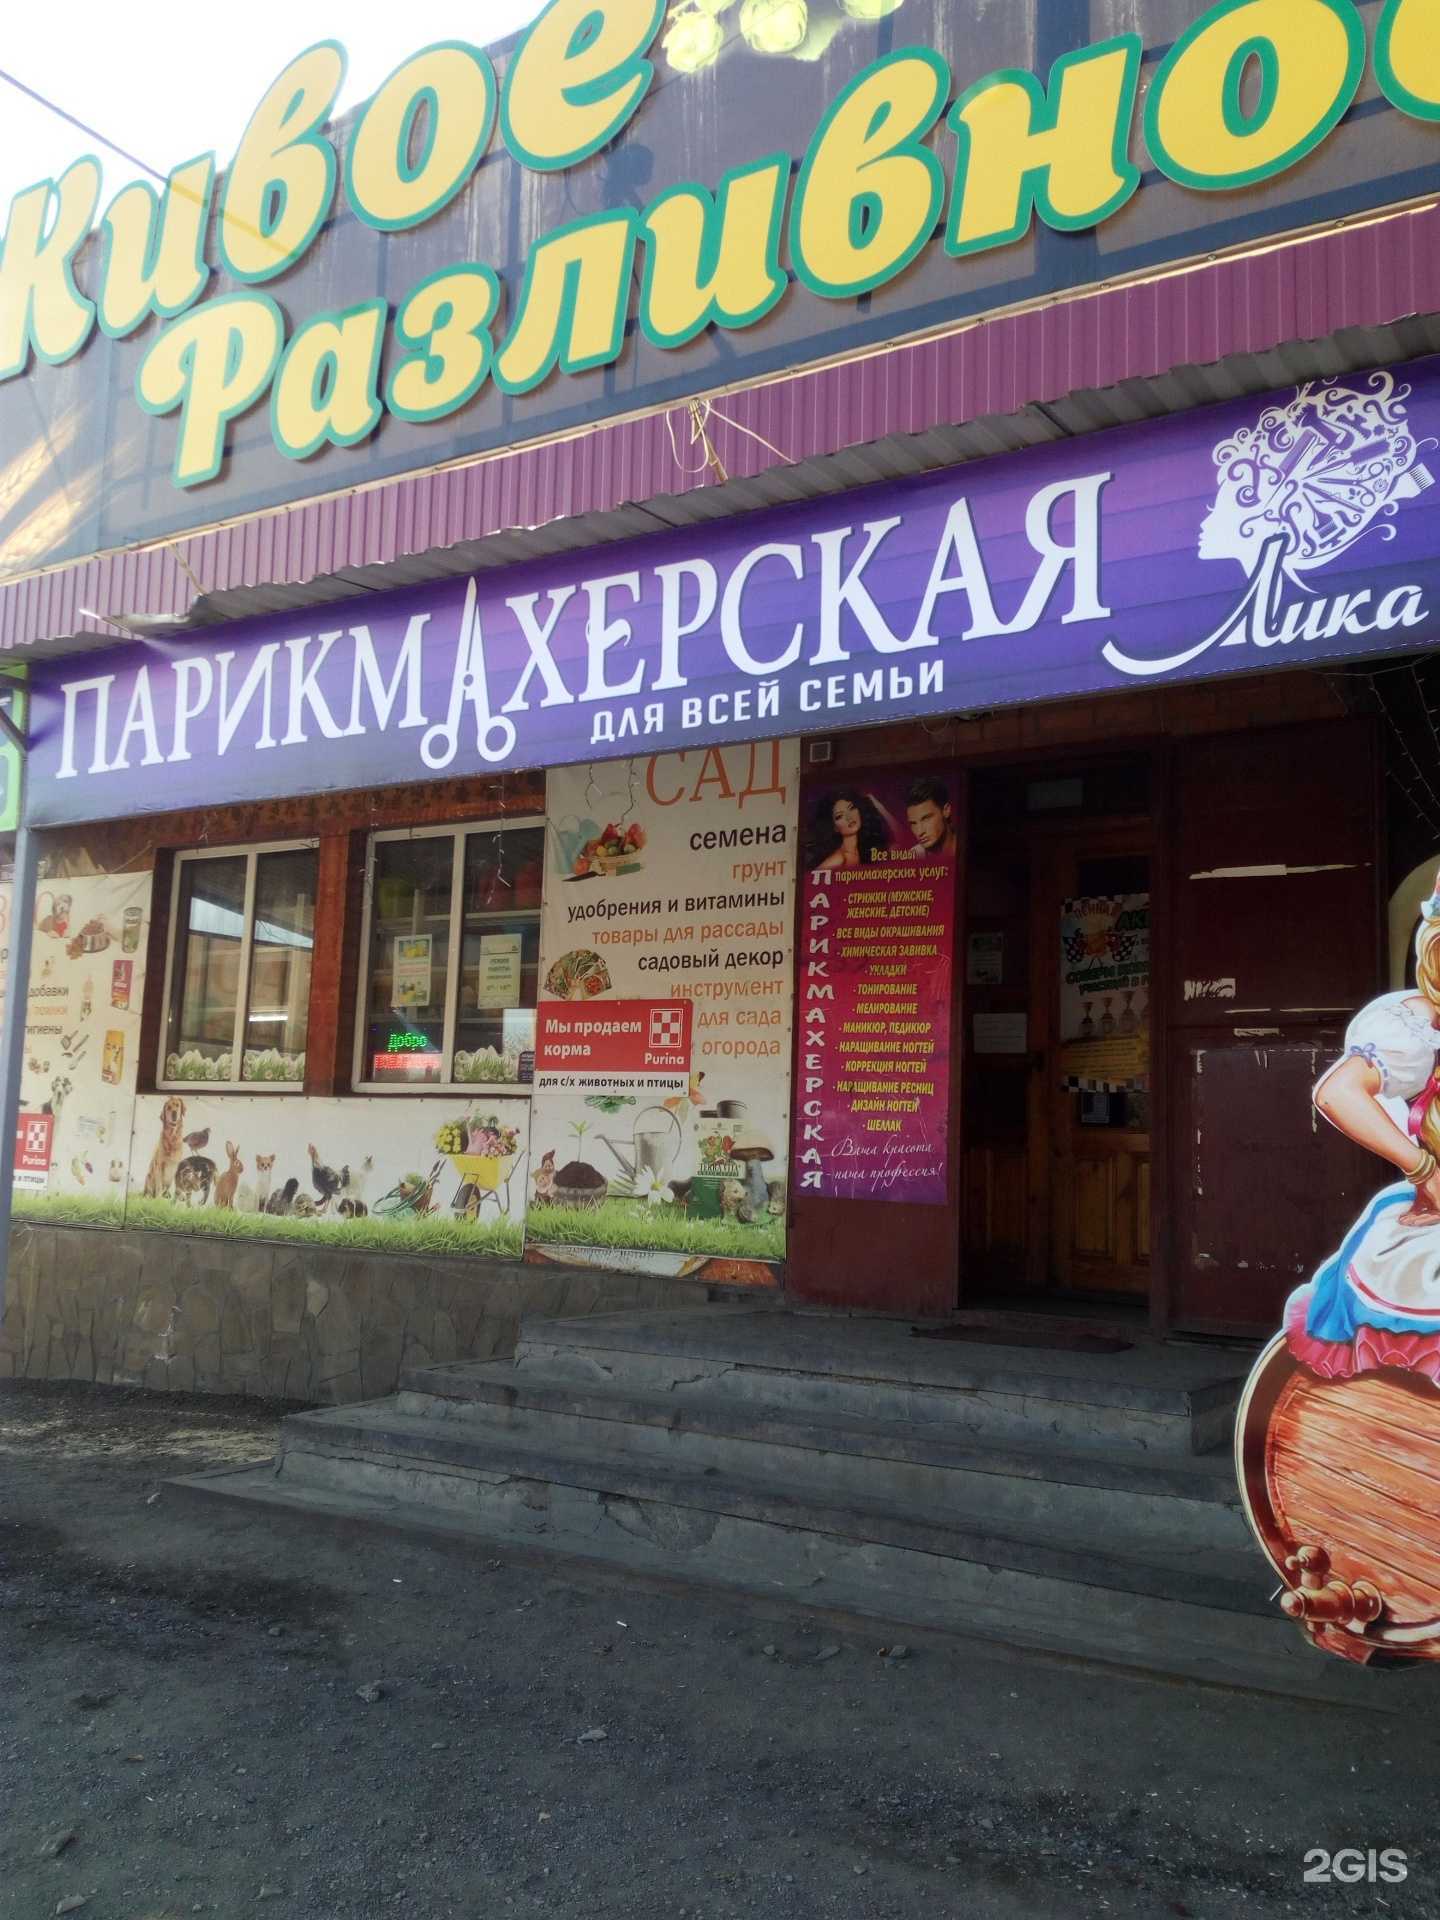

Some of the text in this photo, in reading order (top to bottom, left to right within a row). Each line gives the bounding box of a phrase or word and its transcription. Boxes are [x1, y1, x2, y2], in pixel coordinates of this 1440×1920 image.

[1101, 533, 1429, 675] Лика
[55, 471, 1112, 779] ПАРИКМАХЕРСКАЯ
[590, 659, 944, 744] ДЛЯ ВСЕЙ СЕМЬИ
[646, 738, 787, 808] САД
[690, 824, 786, 850] семена
[871, 848, 915, 861] Все виды
[732, 860, 786, 882] грунт
[835, 866, 949, 884] парикмахерских услуг:
[568, 890, 784, 922] удобрения и витамины
[848, 891, 887, 905] СТРИЖКИ
[889, 904, 930, 919] ДЕТСКИЕ)
[592, 920, 784, 949] товары для рассады
[836, 925, 945, 940] ВСЕ ВИДЫ ОКРАШИВАНИЯ
[841, 944, 937, 958] ХИМИЧЕСКАЯ ЗАВИВКА
[638, 949, 783, 972] садовый декор
[869, 964, 907, 976] УКЛАДКИ
[671, 979, 783, 1000] инструмент
[857, 983, 918, 995] ТОНИРОВАНИЕ
[857, 1003, 918, 1014] МЕЛИРОВАНИЕ
[698, 1007, 782, 1029] для сада
[546, 1020, 642, 1037] Мы продаем
[800, 869, 835, 1189] ПАРИКМАХЕРСКАЯ
[843, 1022, 931, 1035] МАНИКЮР, ПЕДИКЮР
[388, 1033, 428, 1052] Добро
[702, 1040, 780, 1058] огорода
[839, 1040, 934, 1055] НАРАЩИВАНИЕ НОГТЕЙ
[544, 1045, 591, 1060] корма
[644, 1053, 685, 1065] Purina
[845, 1059, 927, 1073] КОРРЕКЦИЯ НОГТЕЙ
[539, 1077, 684, 1089] для с/х животных и птицы
[837, 1081, 934, 1095] НАРАЩИВАНИЕ РЕСНИЦ
[851, 1097, 919, 1113] ДИЗАЙН НОГТЕЙ
[867, 1120, 902, 1131] ШЕЛЛАК
